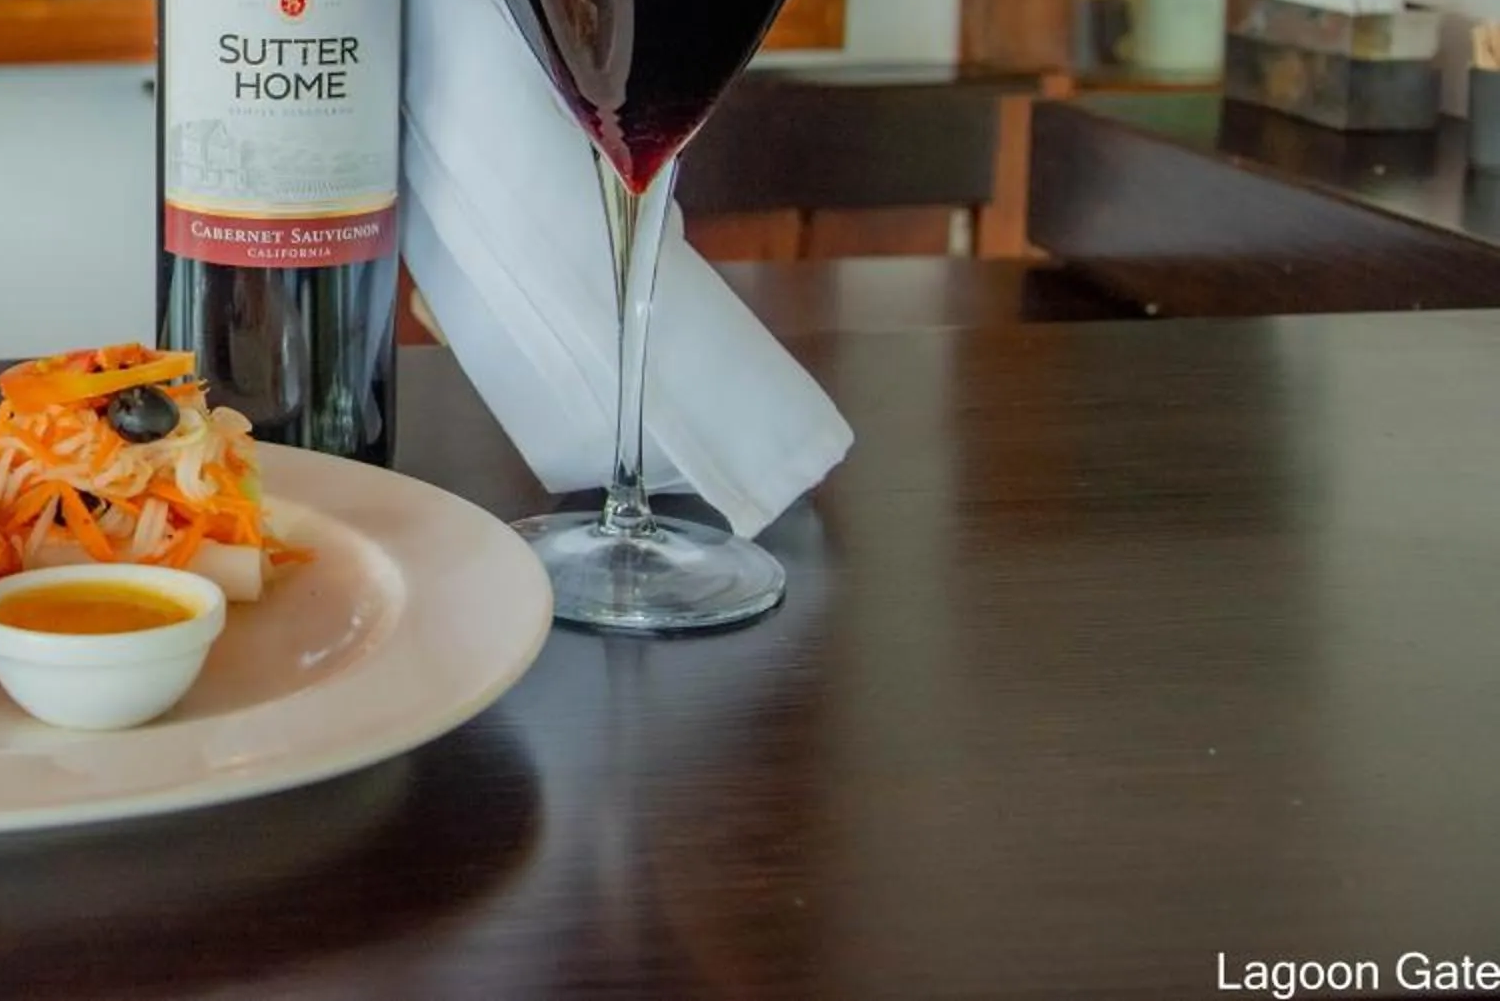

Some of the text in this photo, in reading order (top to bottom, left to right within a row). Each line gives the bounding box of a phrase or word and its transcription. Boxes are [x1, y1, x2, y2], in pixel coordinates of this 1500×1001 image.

[219, 34, 360, 66] SUTTER
[235, 71, 347, 100] HOME
[190, 220, 380, 244] CABERNET SAUVIGNON
[247, 247, 332, 259] CALIFORNIA
